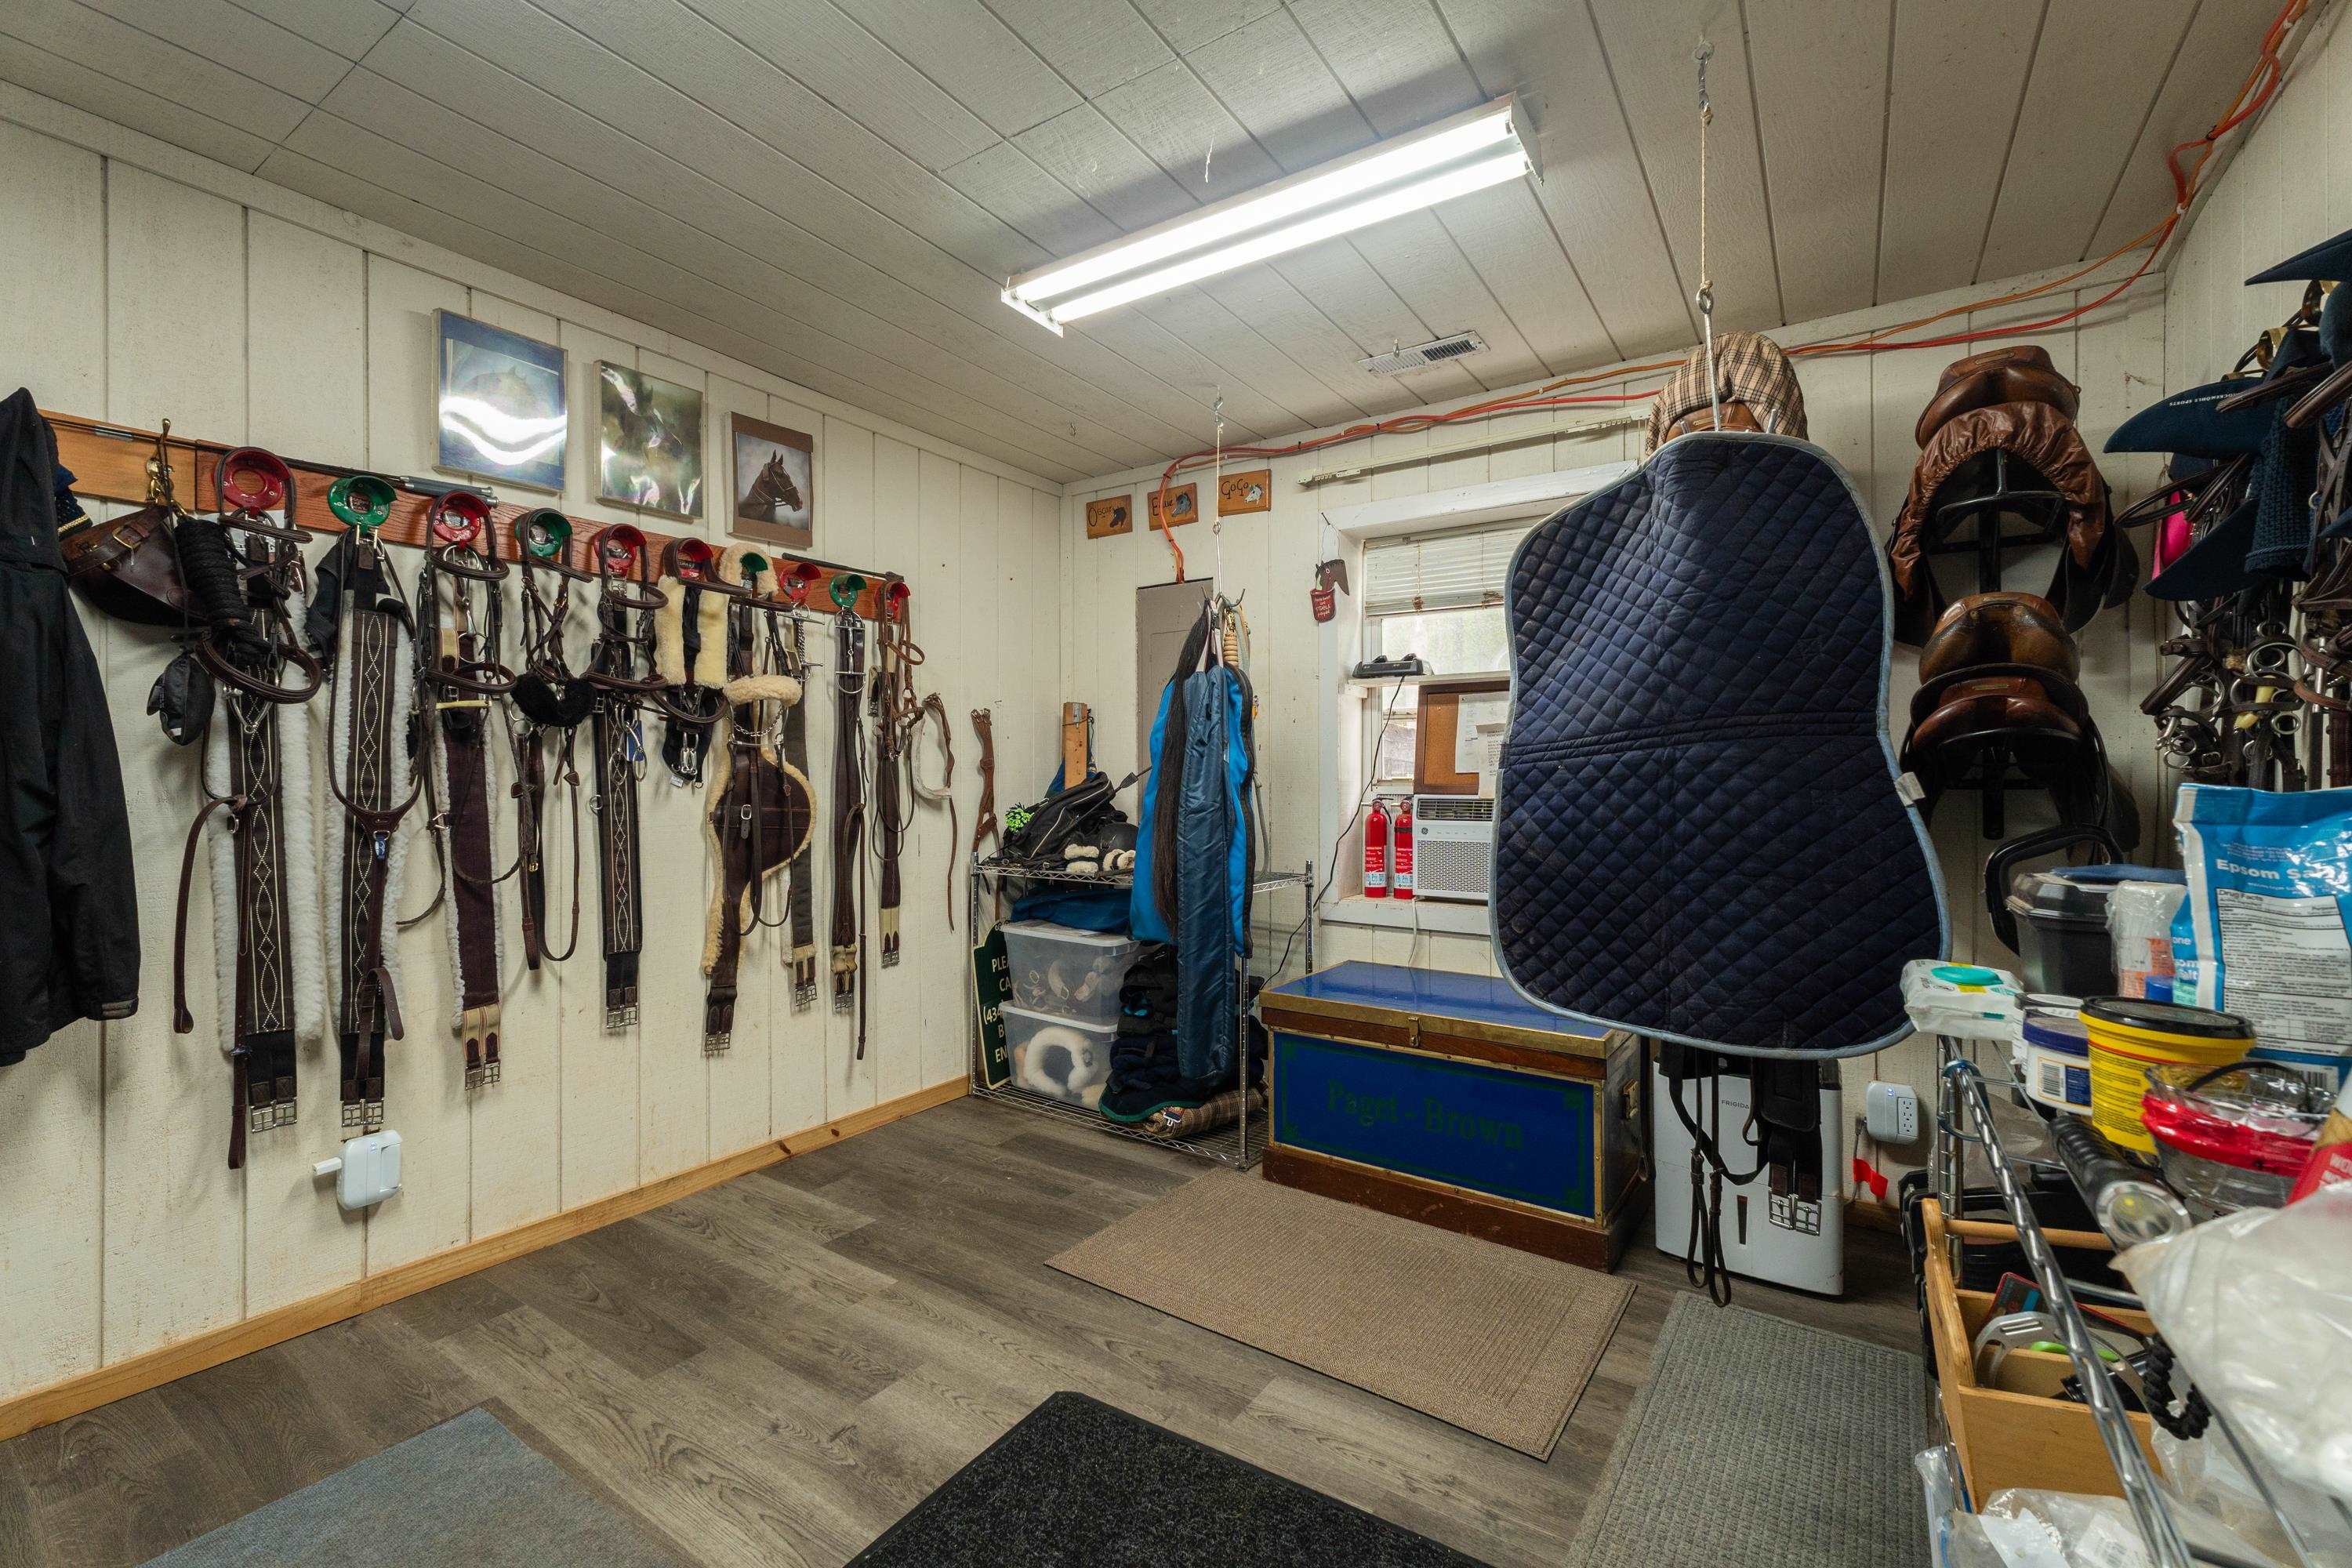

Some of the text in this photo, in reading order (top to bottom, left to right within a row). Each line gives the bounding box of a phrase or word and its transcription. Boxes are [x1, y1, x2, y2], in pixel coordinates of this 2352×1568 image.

[2169, 398, 2193, 407] SPORTS
[1221, 478, 1249, 499] GoGo
[2215, 858, 2281, 880] Epsom
